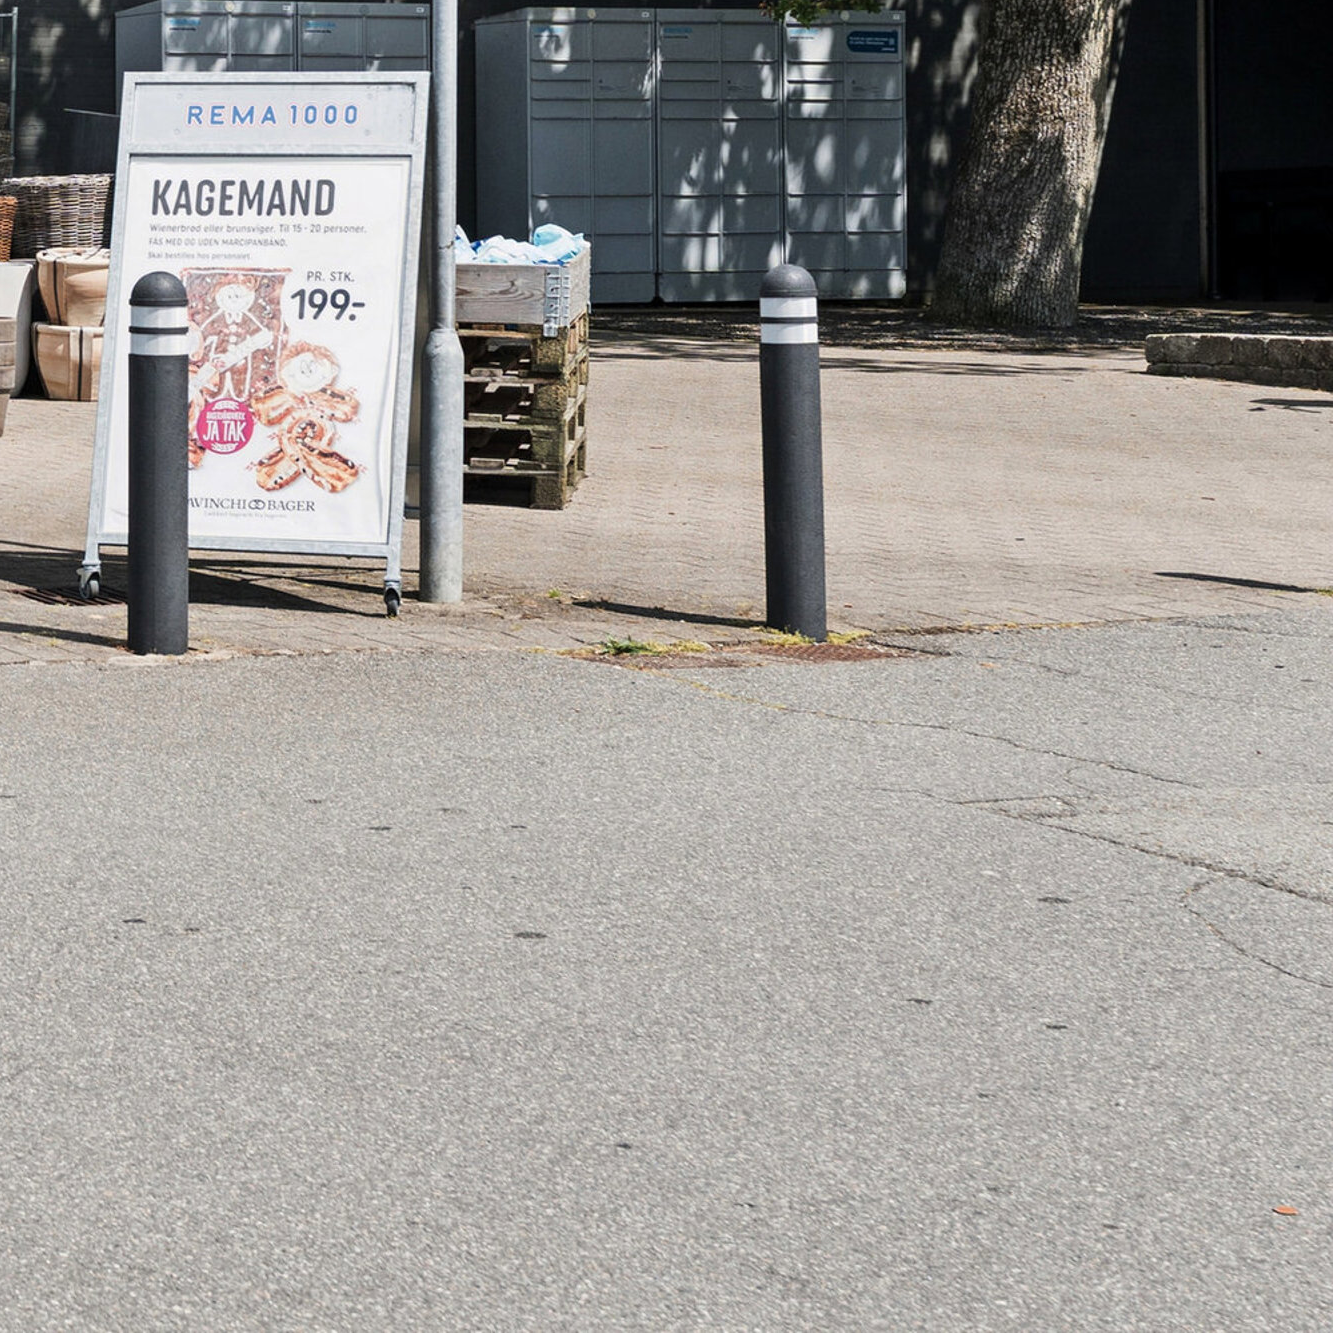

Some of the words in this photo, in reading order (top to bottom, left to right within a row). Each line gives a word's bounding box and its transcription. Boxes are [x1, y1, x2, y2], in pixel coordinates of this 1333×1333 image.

[186, 103, 278, 126] REMA
[289, 103, 359, 126] 1000
[151, 179, 336, 217] KAGEMAND
[150, 224, 201, 233] Wienerbrød
[203, 224, 224, 233] eller
[279, 224, 290, 233] Til
[293, 224, 302, 233] 15
[310, 224, 321, 233] 20
[165, 237, 182, 246] MED
[306, 270, 326, 282] PR.
[330, 271, 355, 283] STK.
[202, 420, 220, 441] JA
[222, 420, 247, 442] TAK
[188, 497, 247, 510] AVINCHI
[267, 500, 316, 512] BAGER
